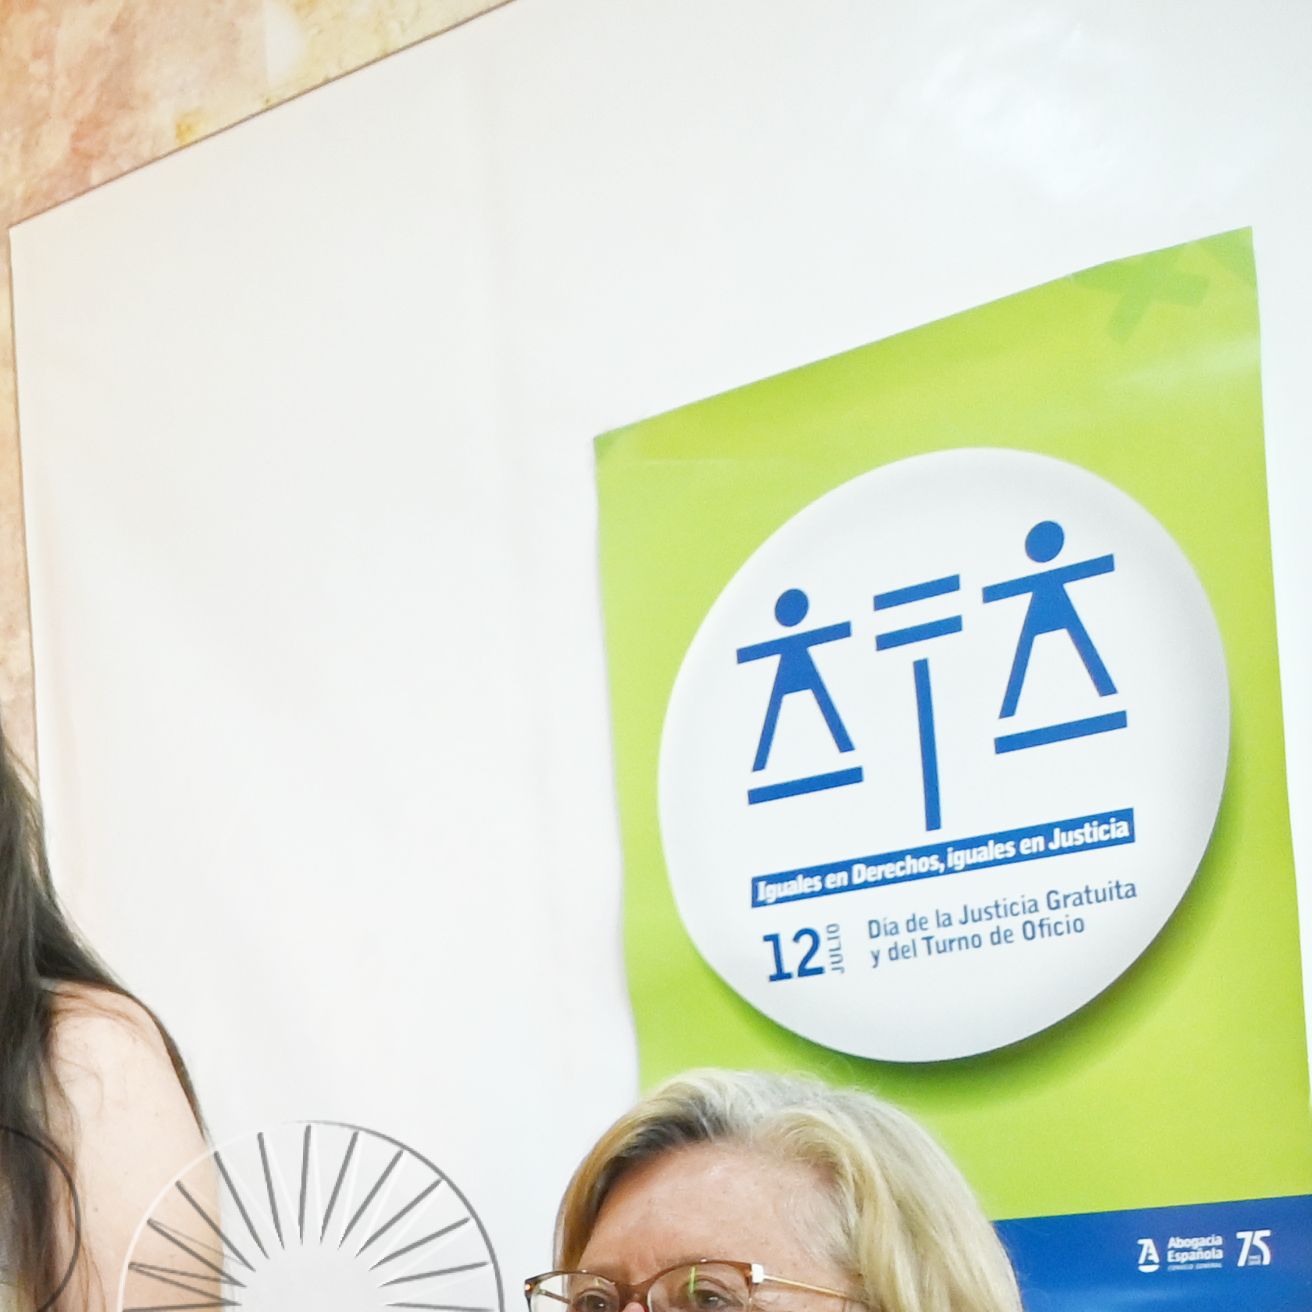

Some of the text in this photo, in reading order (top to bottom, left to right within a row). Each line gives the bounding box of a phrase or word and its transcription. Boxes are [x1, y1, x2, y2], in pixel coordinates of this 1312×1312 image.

[757, 818, 1130, 903] Iguales en Derechos, iguales en Justicia
[868, 880, 1137, 939] Día de la Justicia Gratuita
[763, 927, 825, 982] 12
[826, 923, 845, 974] JULIO
[871, 914, 1086, 968] y del Turno de Oficio
[1167, 1247, 1224, 1263] Española
[1236, 1229, 1272, 1267] 75
